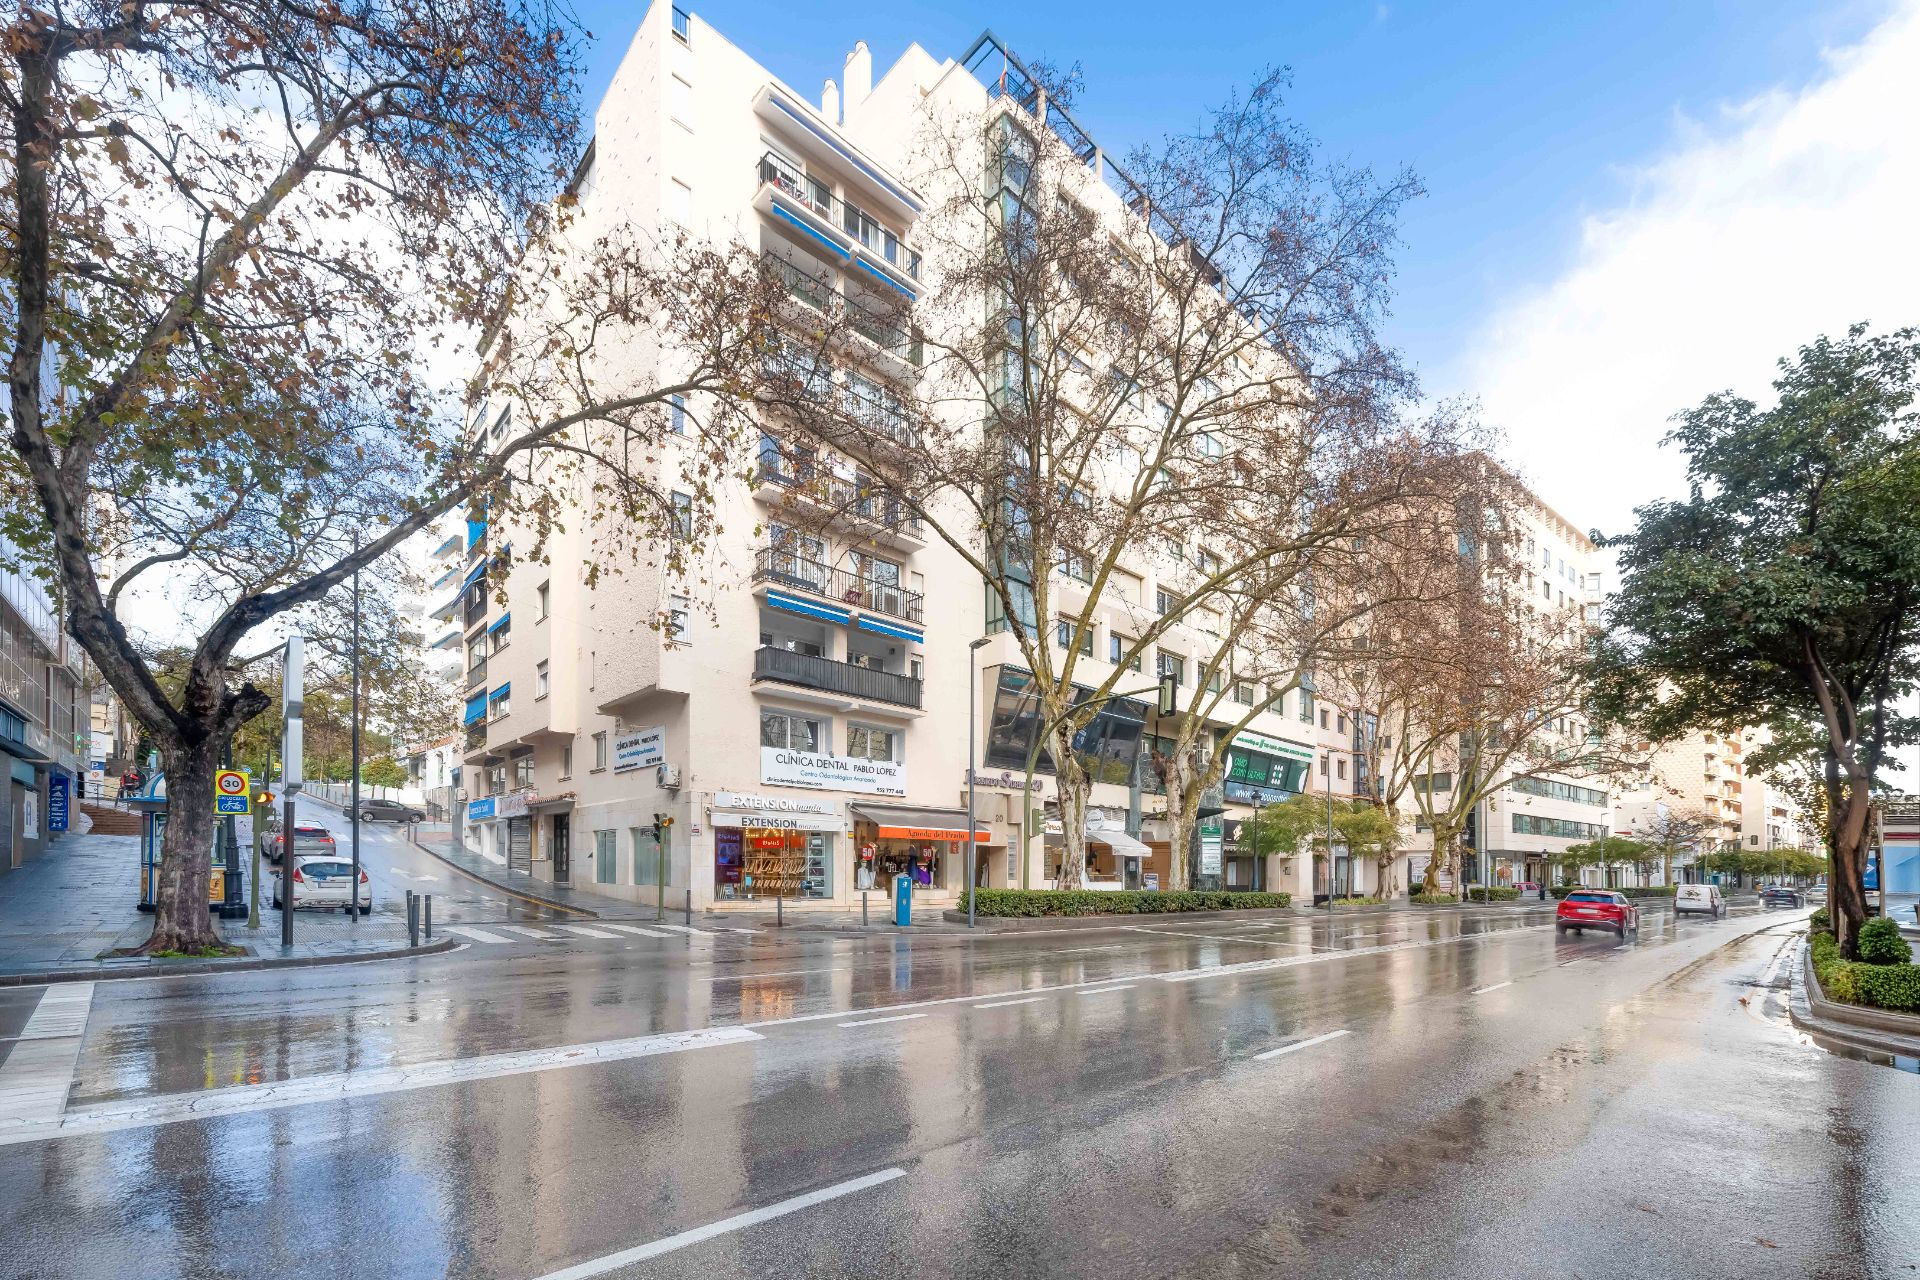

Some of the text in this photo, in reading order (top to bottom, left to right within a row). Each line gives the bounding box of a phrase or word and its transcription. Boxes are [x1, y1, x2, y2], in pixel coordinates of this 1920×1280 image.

[775, 752, 897, 777] CLÍNICA DENTAL PABLO LÓPEZ
[800, 769, 818, 778] Centro
[224, 779, 240, 788] 30
[732, 796, 798, 811] EXTENSION
[741, 817, 798, 829] EXTENSION
[995, 814, 1004, 823] 20
[933, 830, 944, 839] del
[945, 831, 965, 840] Prado
